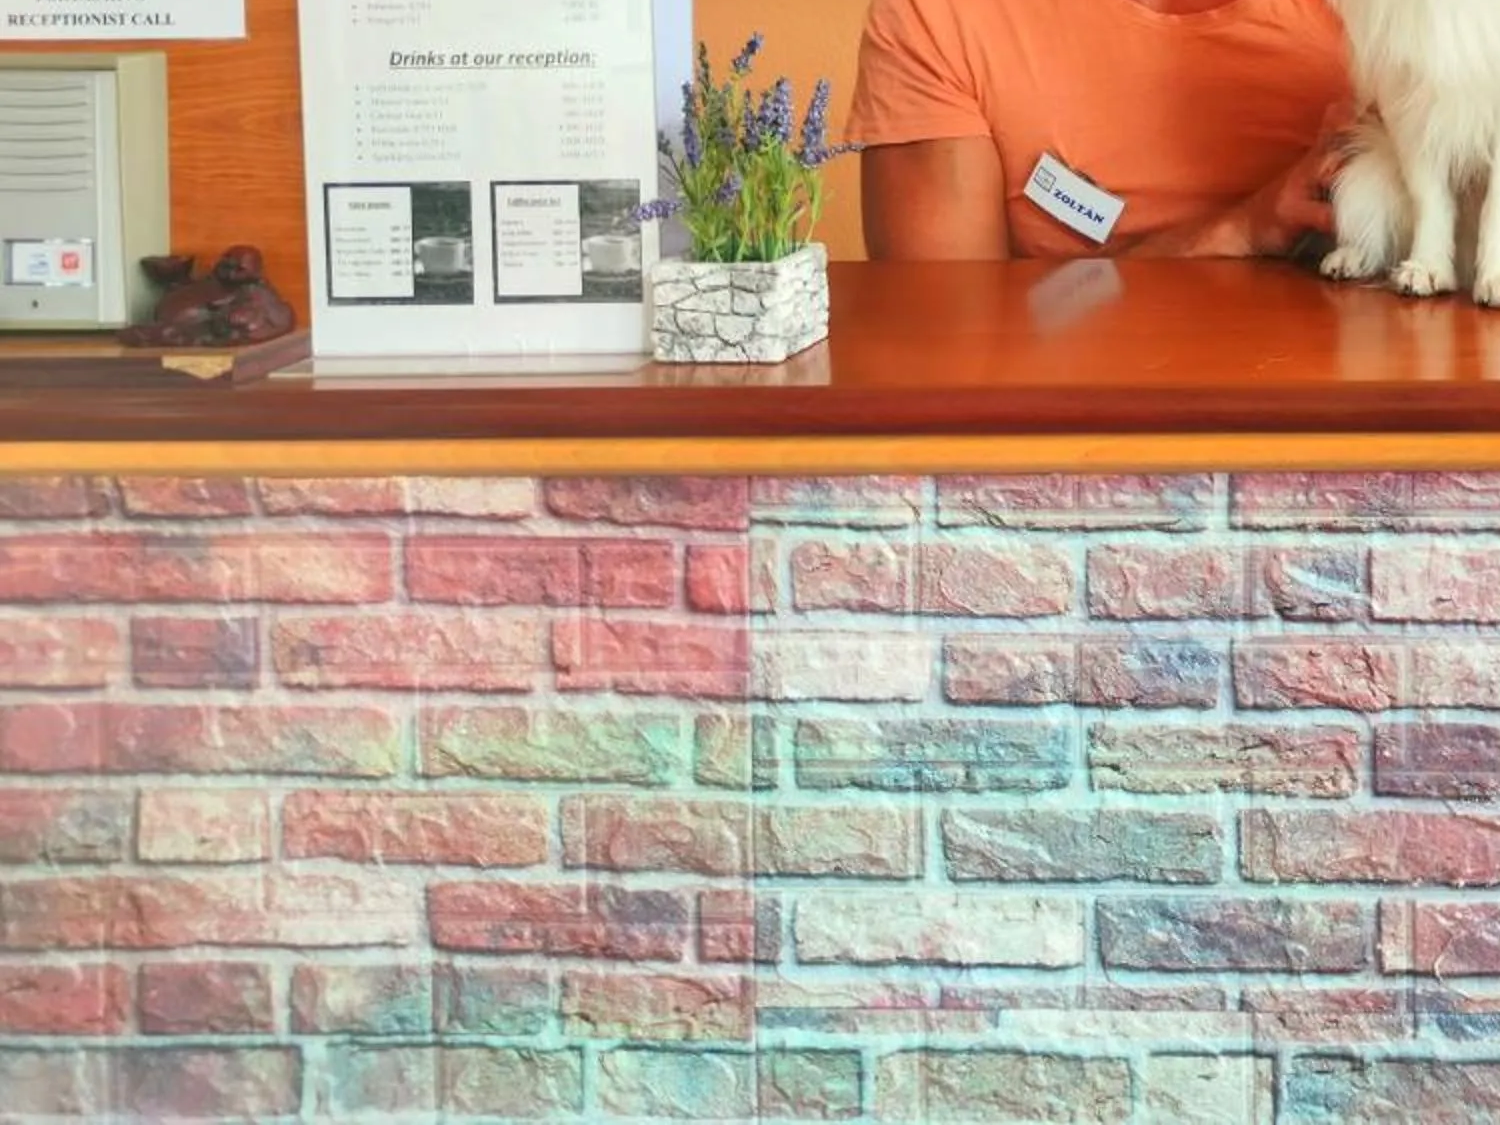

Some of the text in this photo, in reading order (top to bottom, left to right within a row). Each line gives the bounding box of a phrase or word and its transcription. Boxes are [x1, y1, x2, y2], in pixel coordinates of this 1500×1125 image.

[7, 12, 176, 27] RECEPTIONIST CALL
[388, 48, 598, 68] Drinks at our reception:
